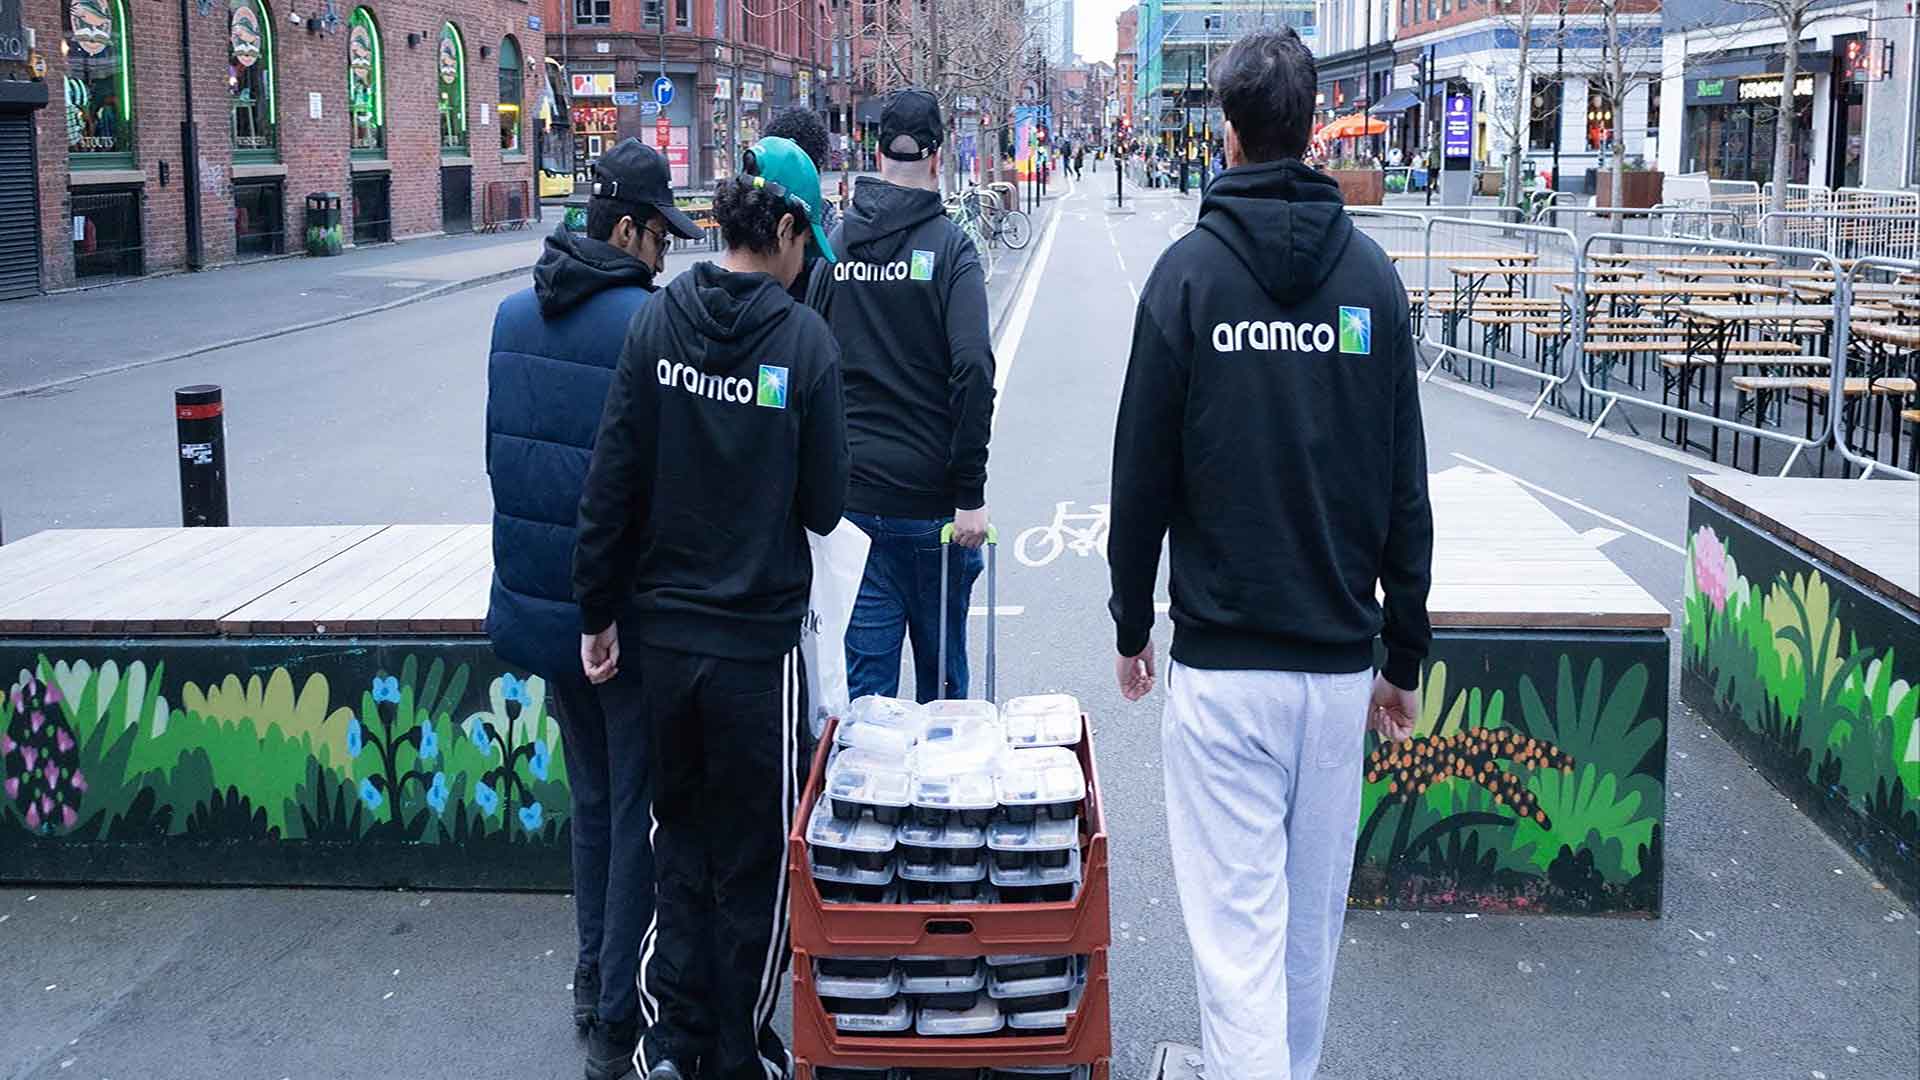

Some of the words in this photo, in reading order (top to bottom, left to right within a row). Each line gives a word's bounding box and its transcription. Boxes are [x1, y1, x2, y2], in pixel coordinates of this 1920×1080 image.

[833, 261, 909, 281] aramco
[1212, 320, 1335, 352] aramco
[657, 358, 753, 404] aramco
